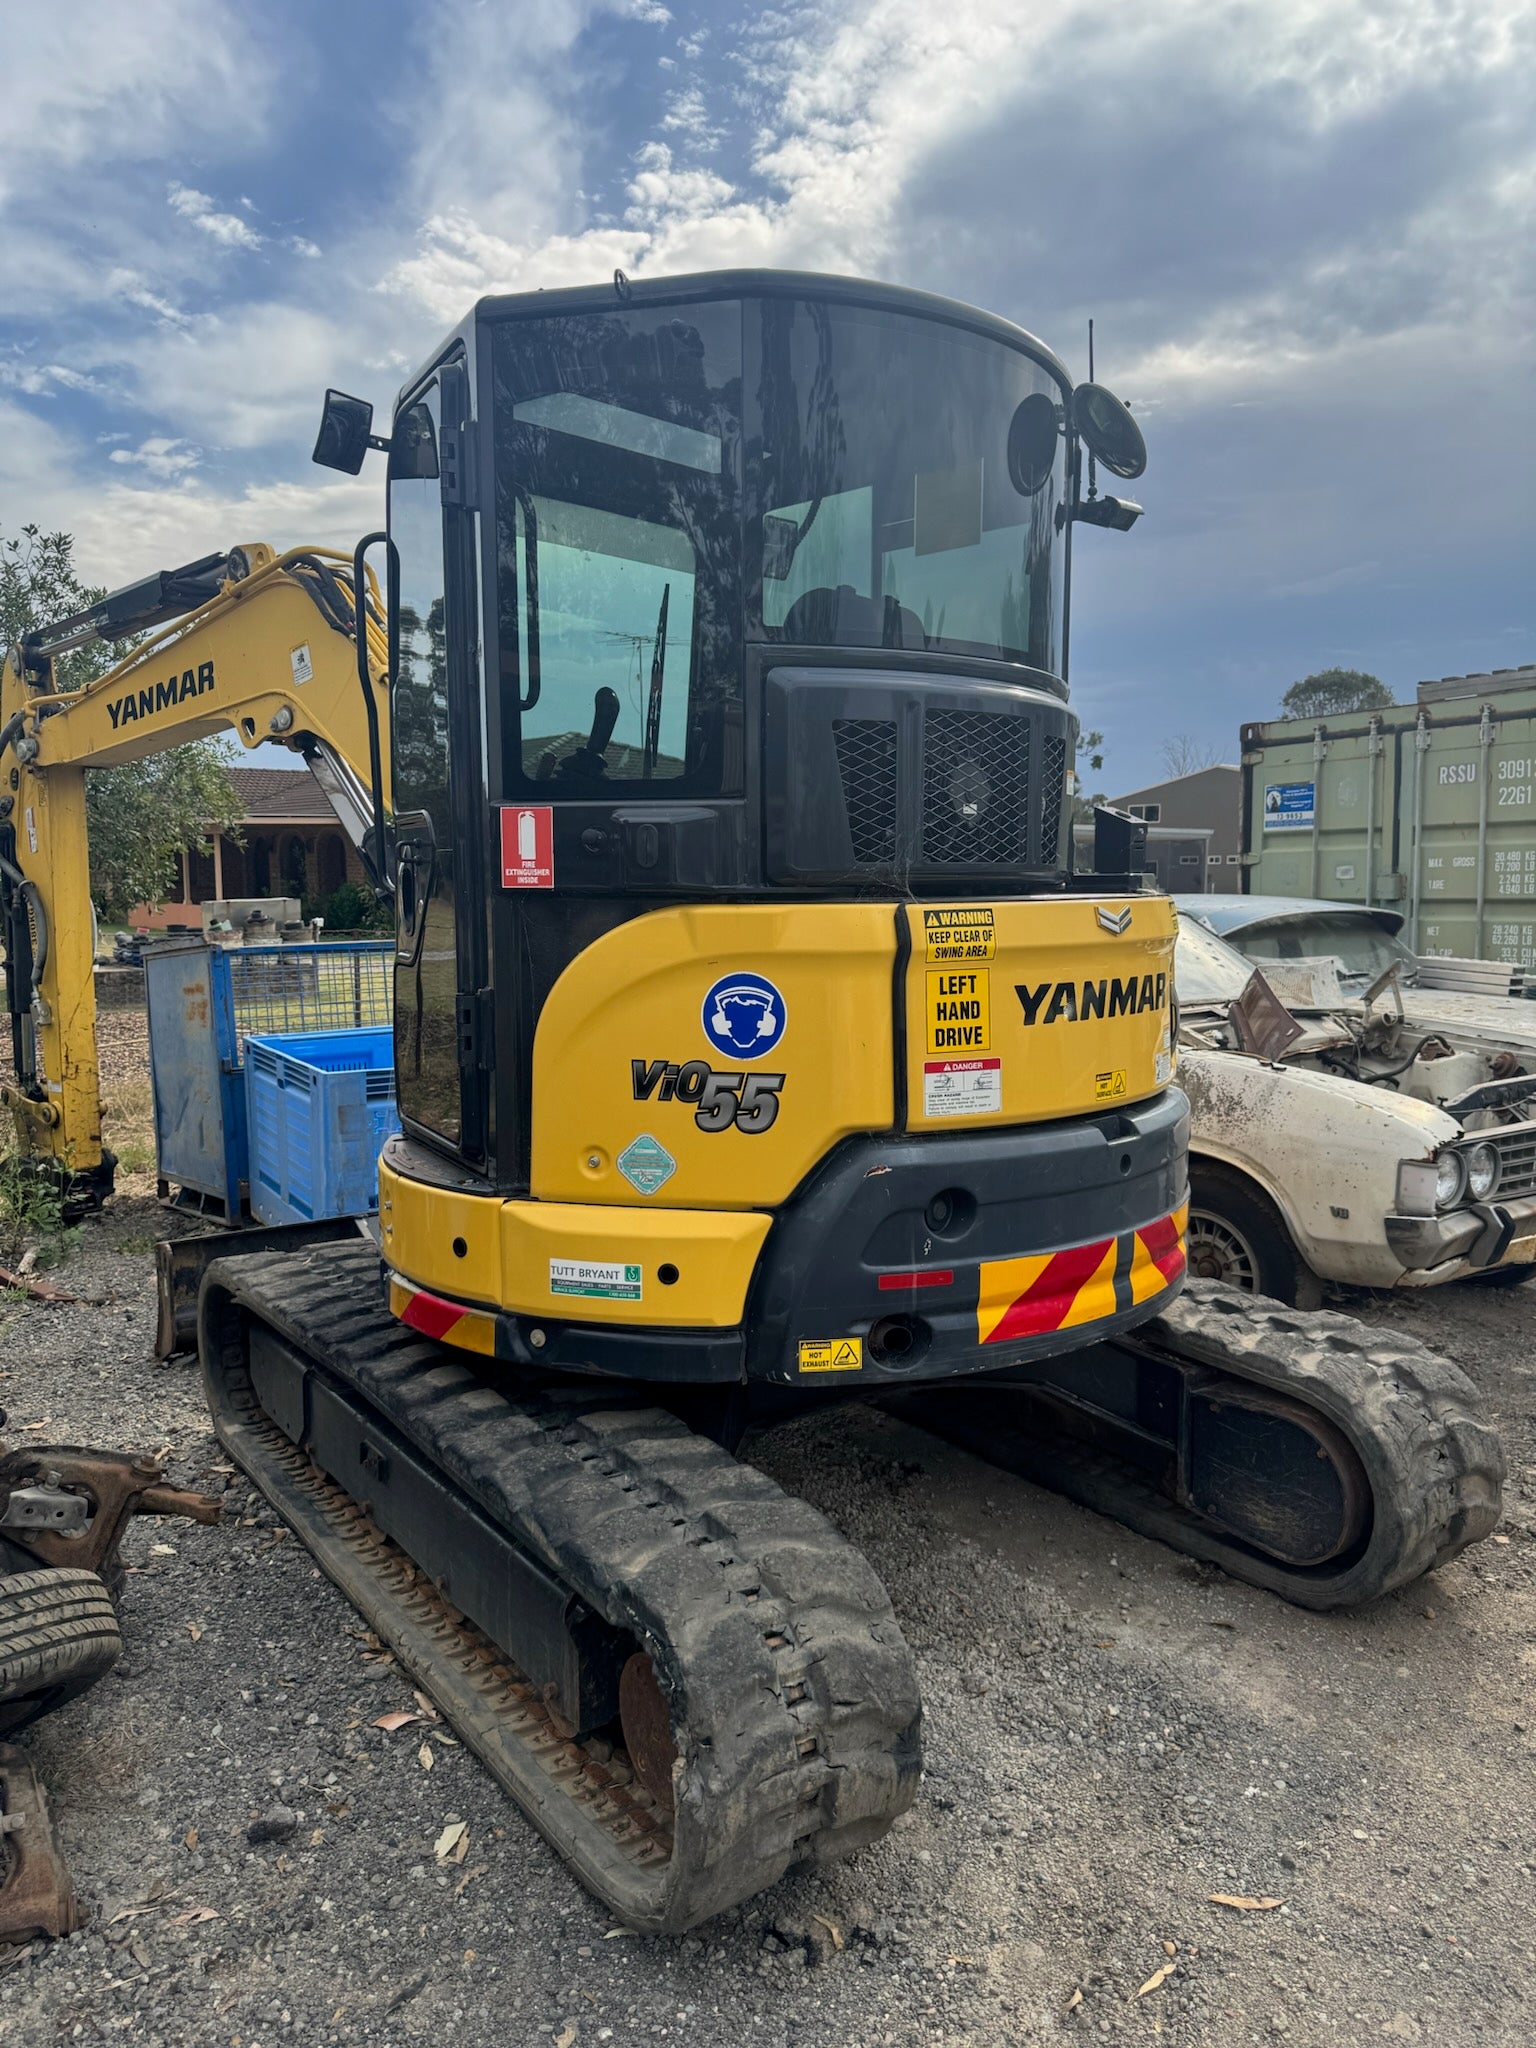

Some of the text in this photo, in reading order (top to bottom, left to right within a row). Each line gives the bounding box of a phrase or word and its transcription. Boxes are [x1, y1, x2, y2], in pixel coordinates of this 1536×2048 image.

[106, 660, 214, 729] YANMAR
[1439, 758, 1536, 785] RSSU 3091
[1498, 785, 1532, 805] 22G1
[1525, 850, 1536, 861] KG
[521, 861, 536, 869] FIRE
[1428, 856, 1476, 868] MAX GROSS
[1524, 861, 1535, 871] LB
[505, 868, 551, 877] EXTINGUISHER
[1524, 873, 1535, 883] KG
[517, 876, 539, 885] INSIDE
[1428, 879, 1445, 890] TARE
[1524, 884, 1535, 894] LB
[939, 910, 993, 926] WARNING
[1426, 926, 1440, 937] NET
[1523, 925, 1533, 935] KG
[928, 929, 993, 944] KEEP CLEAR OF
[1522, 935, 1533, 946] LB
[934, 944, 988, 959] SWING AREA
[939, 974, 977, 995] LEFT
[1014, 972, 1166, 1026] YANMAR
[936, 1000, 980, 1021] HAND
[935, 1026, 983, 1047] DRIVE
[952, 1062, 983, 1071] DANGER
[551, 1265, 621, 1281] TUTT BRYANT
[802, 1360, 830, 1368] EXHAUST
